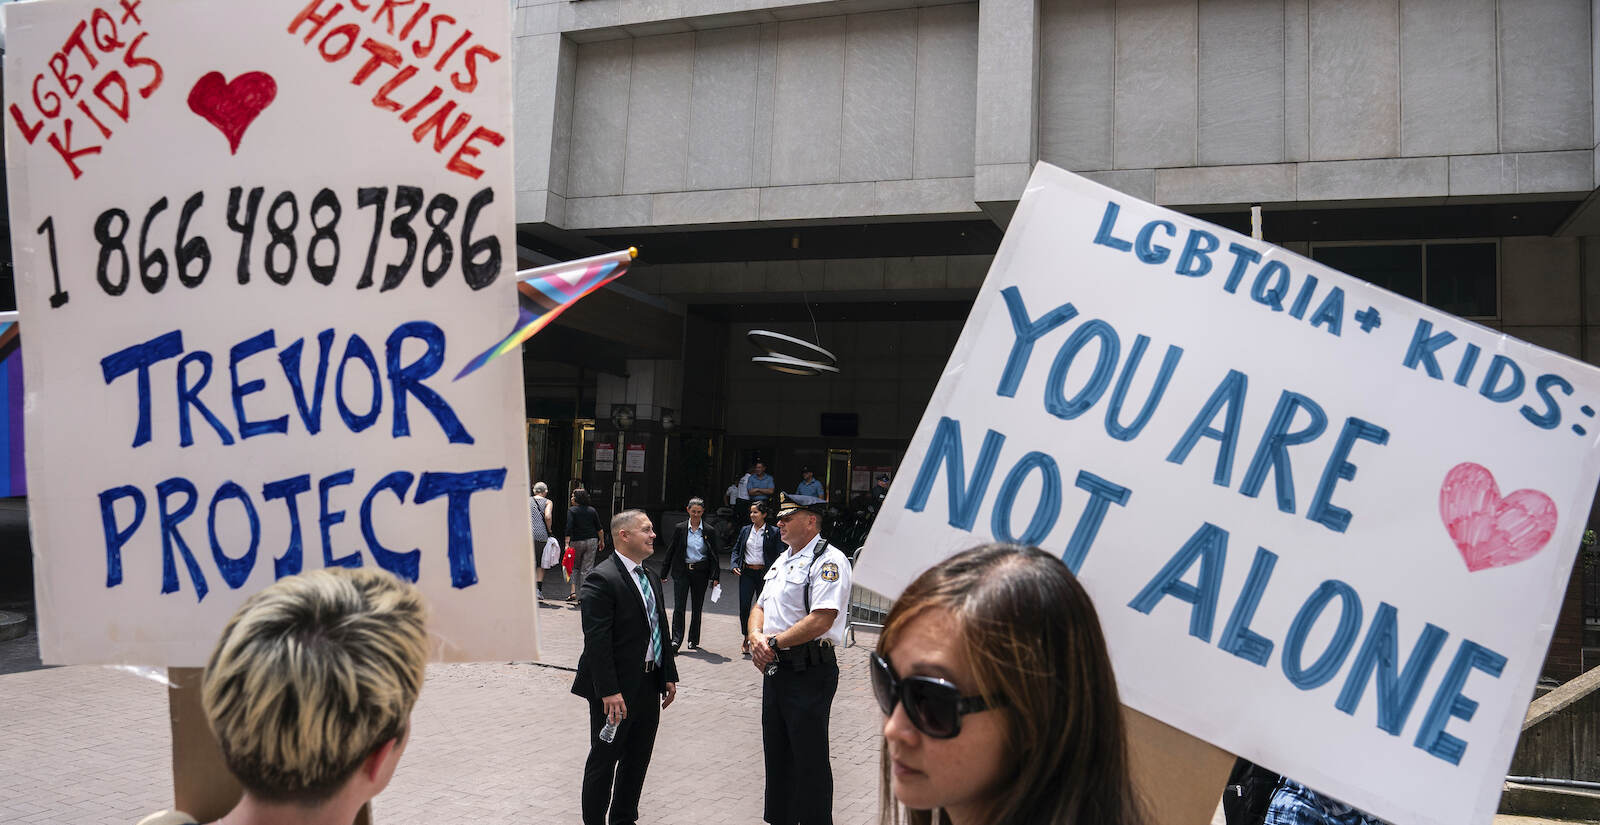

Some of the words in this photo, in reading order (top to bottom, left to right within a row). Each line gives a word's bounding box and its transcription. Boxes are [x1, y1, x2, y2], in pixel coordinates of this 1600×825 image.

[9, 0, 142, 145] LGBTQ+
[47, 31, 164, 180] KIDS
[287, 0, 505, 180] HOTLINE
[350, 0, 501, 93] RISIS
[37, 215, 69, 309] 1
[93, 191, 212, 297] 866
[226, 186, 342, 286] 488
[356, 185, 502, 293] 7386
[1093, 201, 1382, 338] LGBTQIA+
[1402, 318, 1596, 436] KIDS:
[100, 320, 475, 448] TREVOR
[997, 286, 1184, 442] YOU
[1166, 368, 1390, 533] ARE
[98, 467, 507, 603] PROJECT
[904, 416, 1132, 576] NOT
[1127, 521, 1508, 766] ALONE
